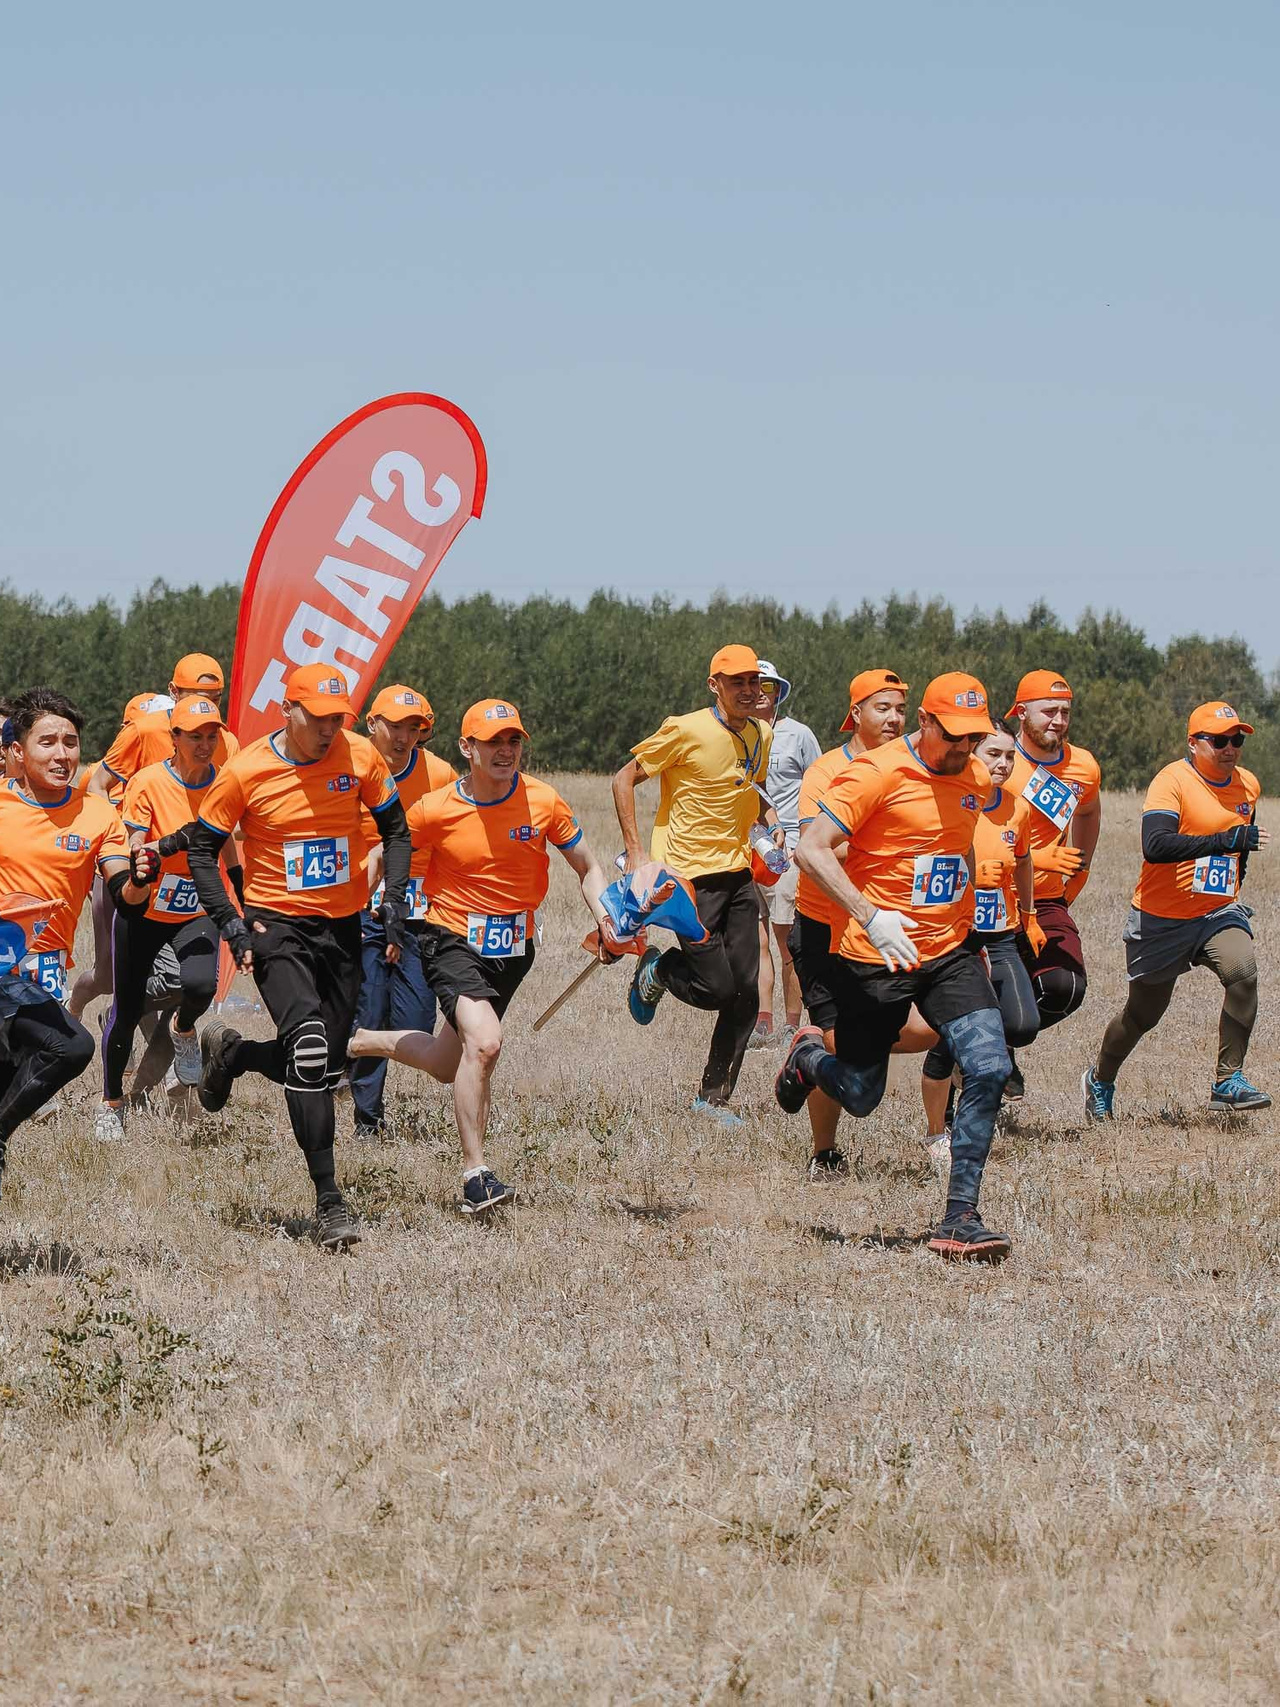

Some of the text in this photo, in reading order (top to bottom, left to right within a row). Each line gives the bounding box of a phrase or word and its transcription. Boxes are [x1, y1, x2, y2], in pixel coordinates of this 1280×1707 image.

[1039, 788, 1063, 813] 61
[309, 846, 320, 854] BI
[306, 855, 336, 879] 45
[936, 862, 946, 870] BI
[930, 873, 955, 897] 61
[1208, 868, 1226, 888] 61
[173, 892, 198, 908] 50
[974, 905, 995, 925] 61
[487, 927, 514, 950] 50
[43, 956, 54, 965] BI
